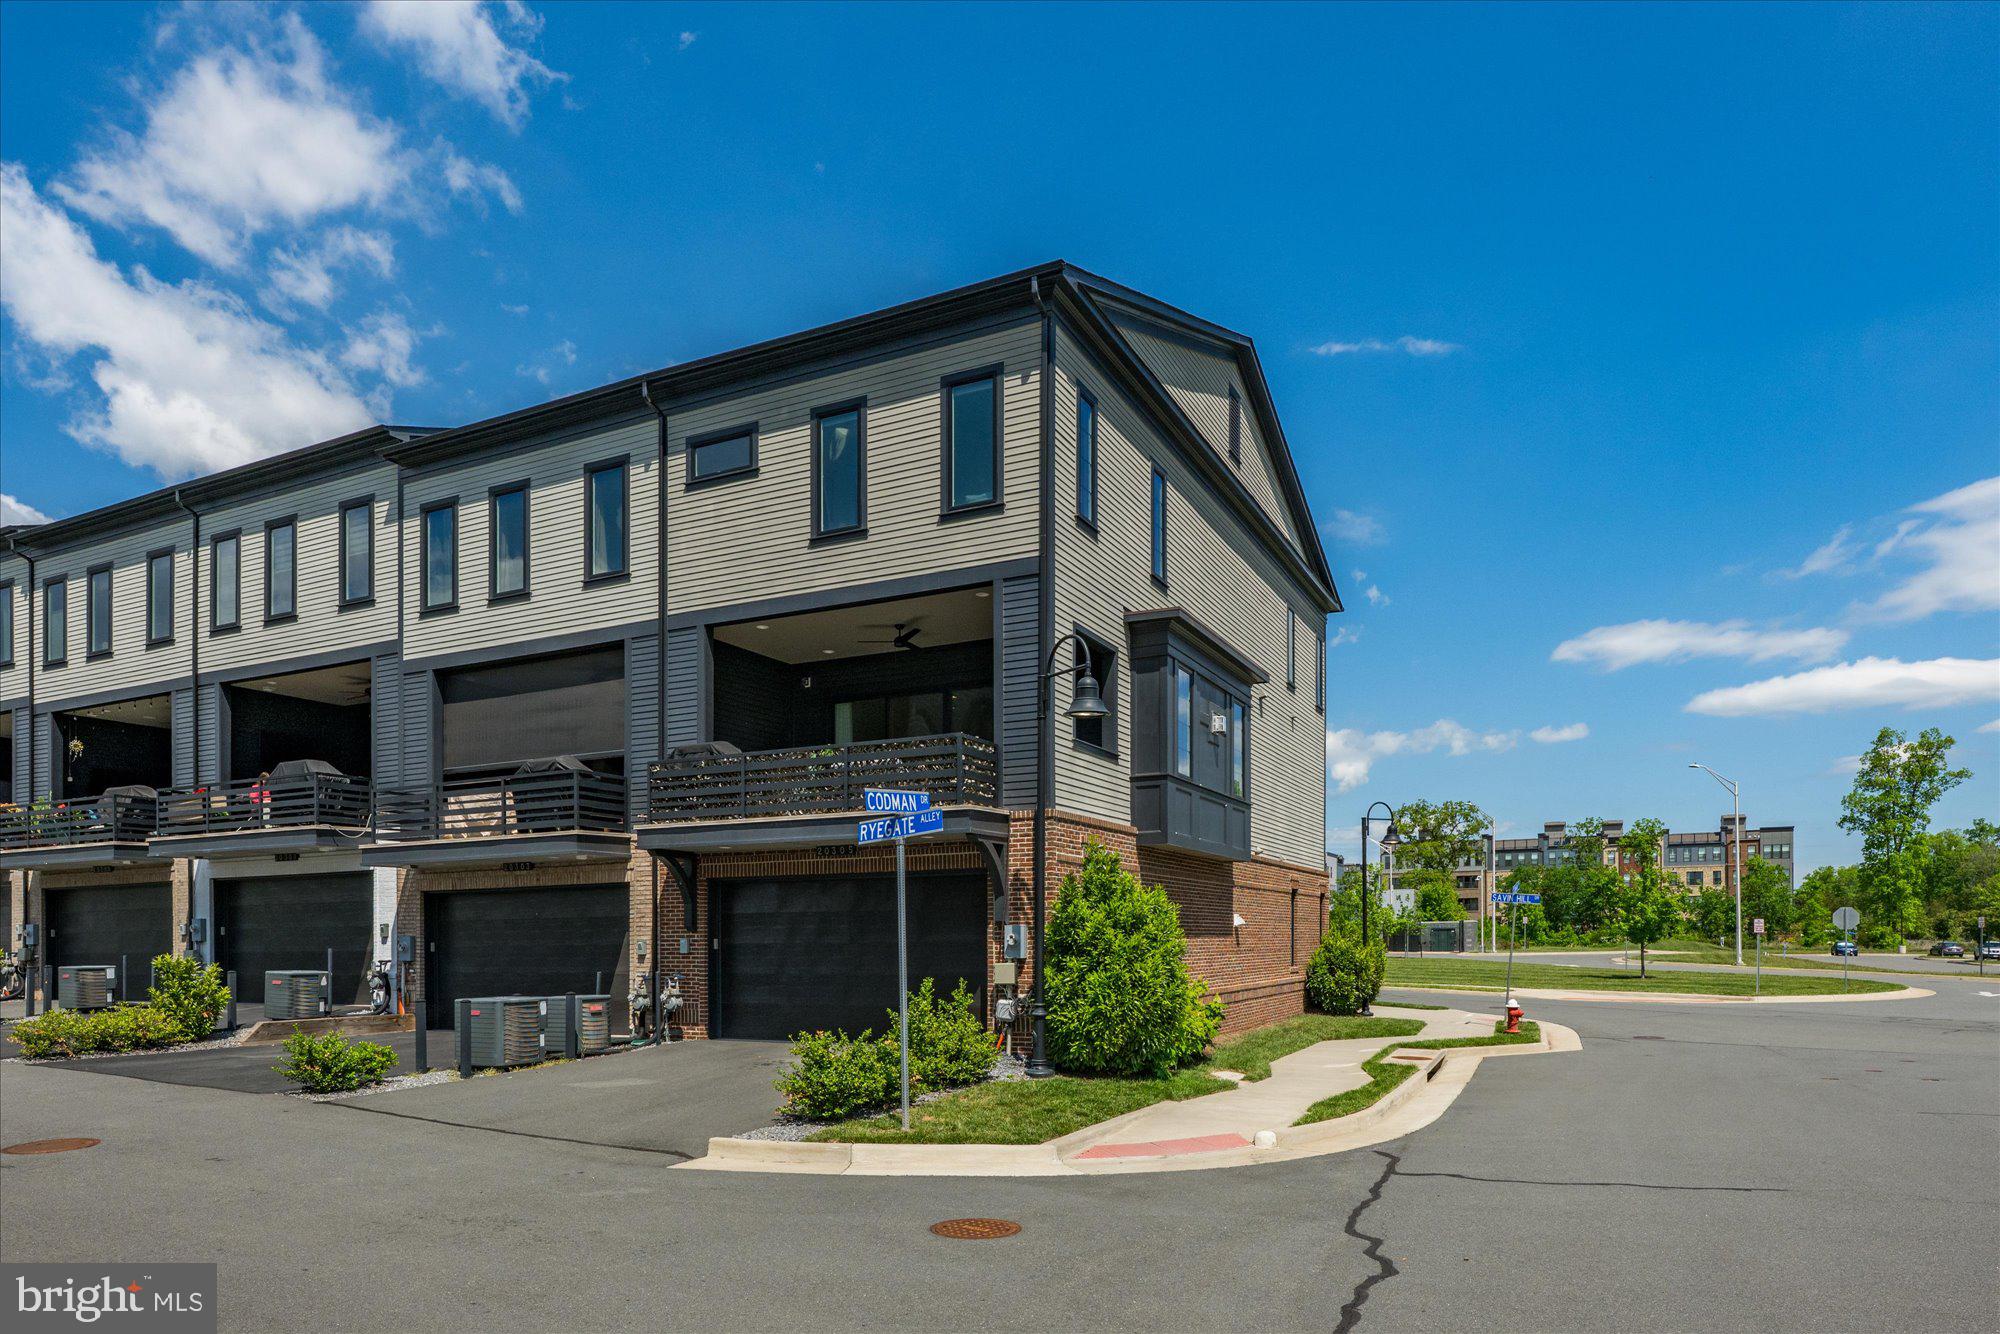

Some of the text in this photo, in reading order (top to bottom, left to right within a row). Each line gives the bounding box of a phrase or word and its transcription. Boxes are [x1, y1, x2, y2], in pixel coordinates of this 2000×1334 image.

[867, 792, 929, 811] CODMAN DR
[860, 811, 941, 841] RYEGATE ALLEY
[817, 845, 853, 855] 20305
[1492, 893, 1514, 903] SAVIN
